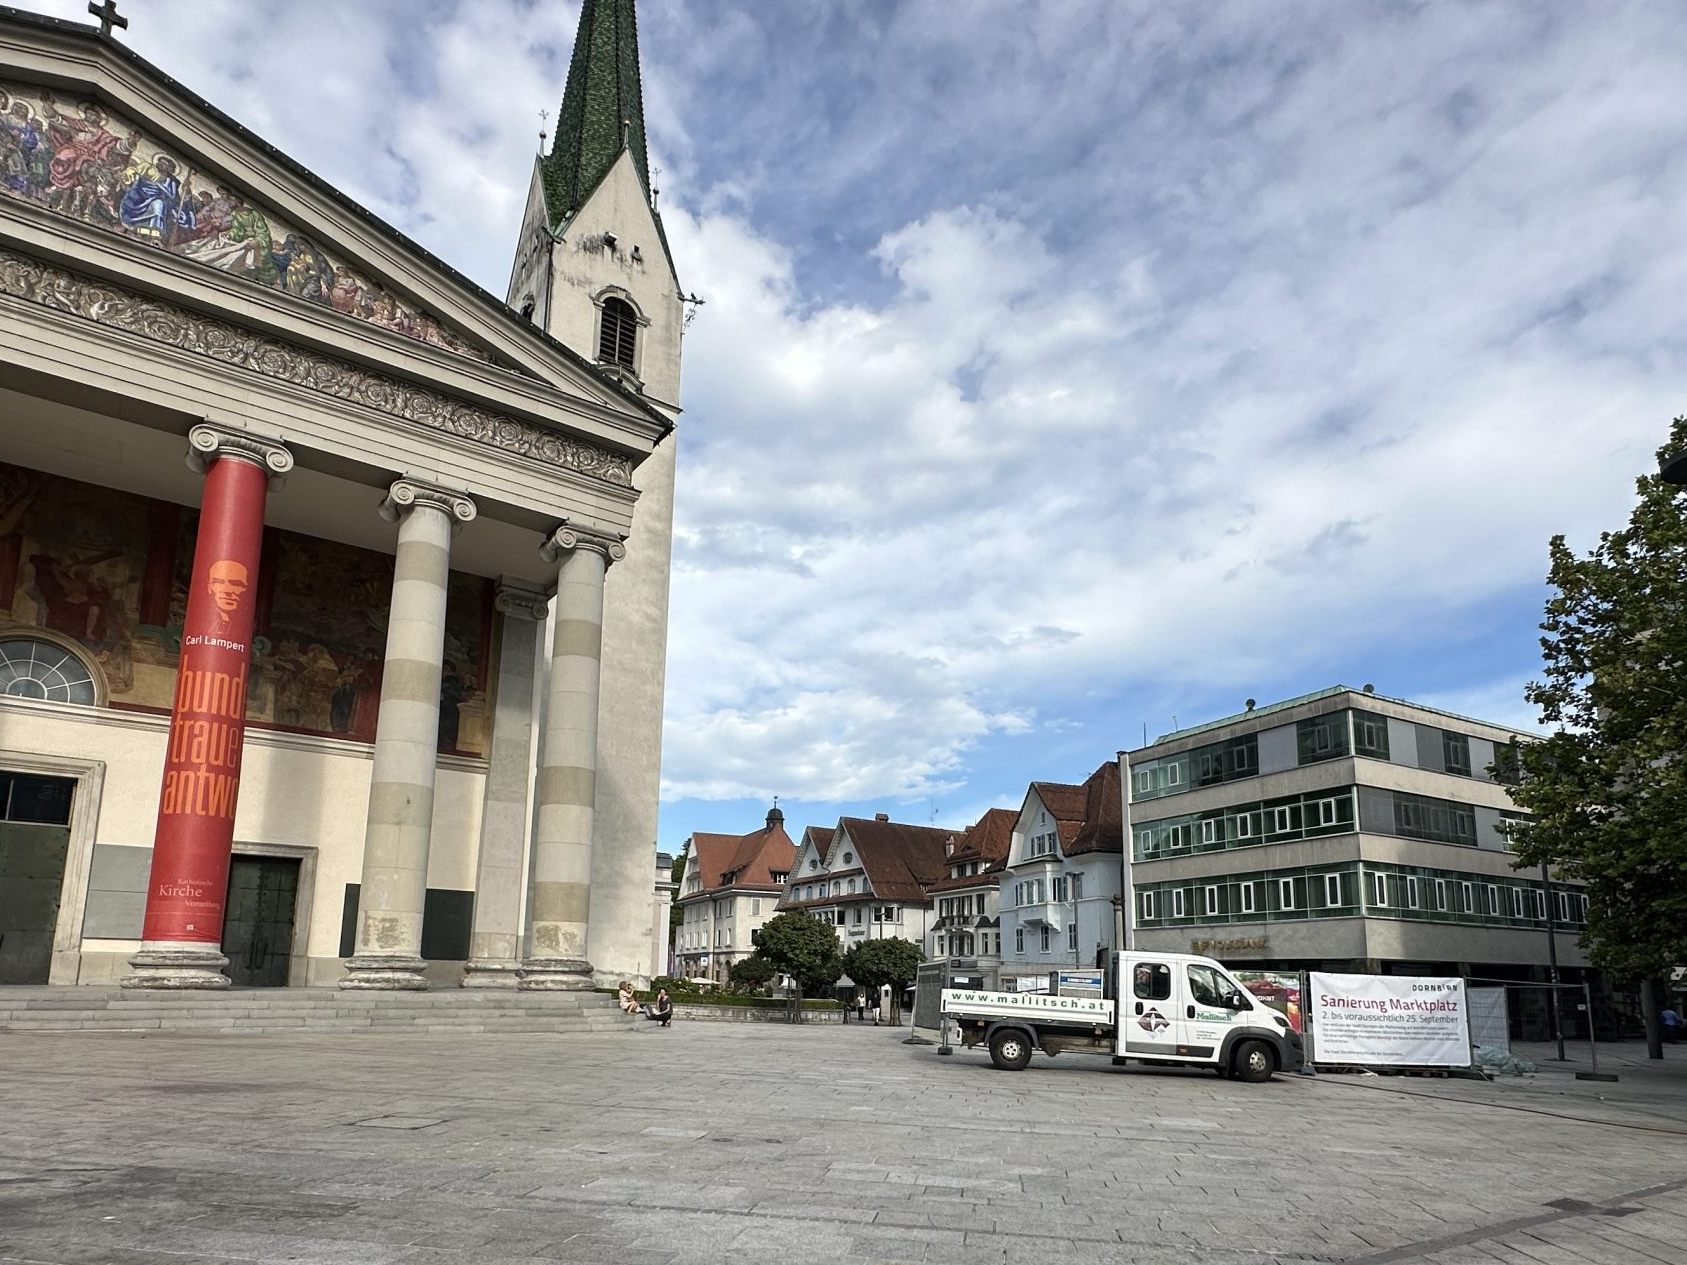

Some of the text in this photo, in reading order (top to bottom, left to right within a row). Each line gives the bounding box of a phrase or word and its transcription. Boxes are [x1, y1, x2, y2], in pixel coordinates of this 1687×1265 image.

[185, 635, 245, 652] Carl Lampert
[159, 885, 202, 896] Kirche
[951, 992, 1105, 1010] www.mallitsch.at
[1320, 994, 1458, 1014] Sanierung Marktplatz
[1196, 1012, 1232, 1021] Mallitsch
[1321, 1010, 1459, 1025] 2. bis voraussichtlich 25. September
